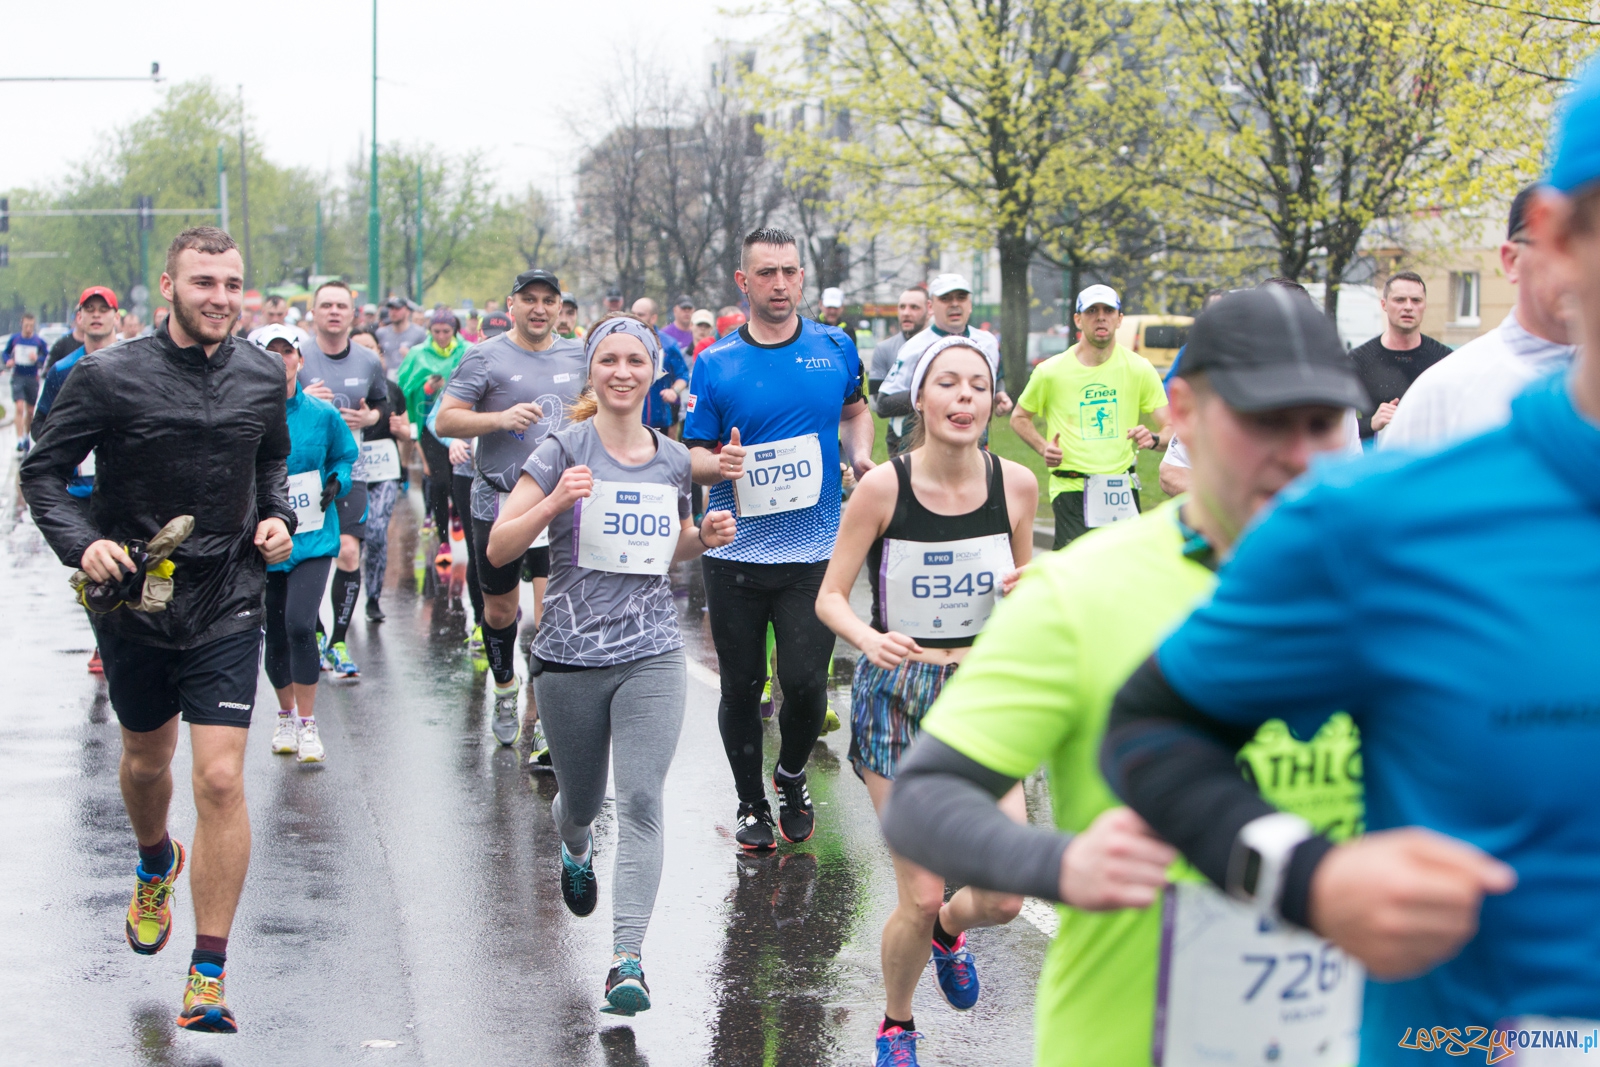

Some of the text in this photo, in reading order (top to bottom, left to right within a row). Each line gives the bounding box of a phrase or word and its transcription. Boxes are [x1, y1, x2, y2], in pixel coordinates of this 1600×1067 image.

[804, 357, 831, 369] ztm
[1085, 388, 1117, 399] Enea
[746, 460, 811, 488] 10790
[774, 484, 791, 492] Jakub
[603, 512, 670, 537] 3008
[627, 539, 650, 547] Iwona
[911, 571, 994, 599] 6349
[338, 581, 359, 625] Kalenji
[939, 602, 969, 610] Joanna
